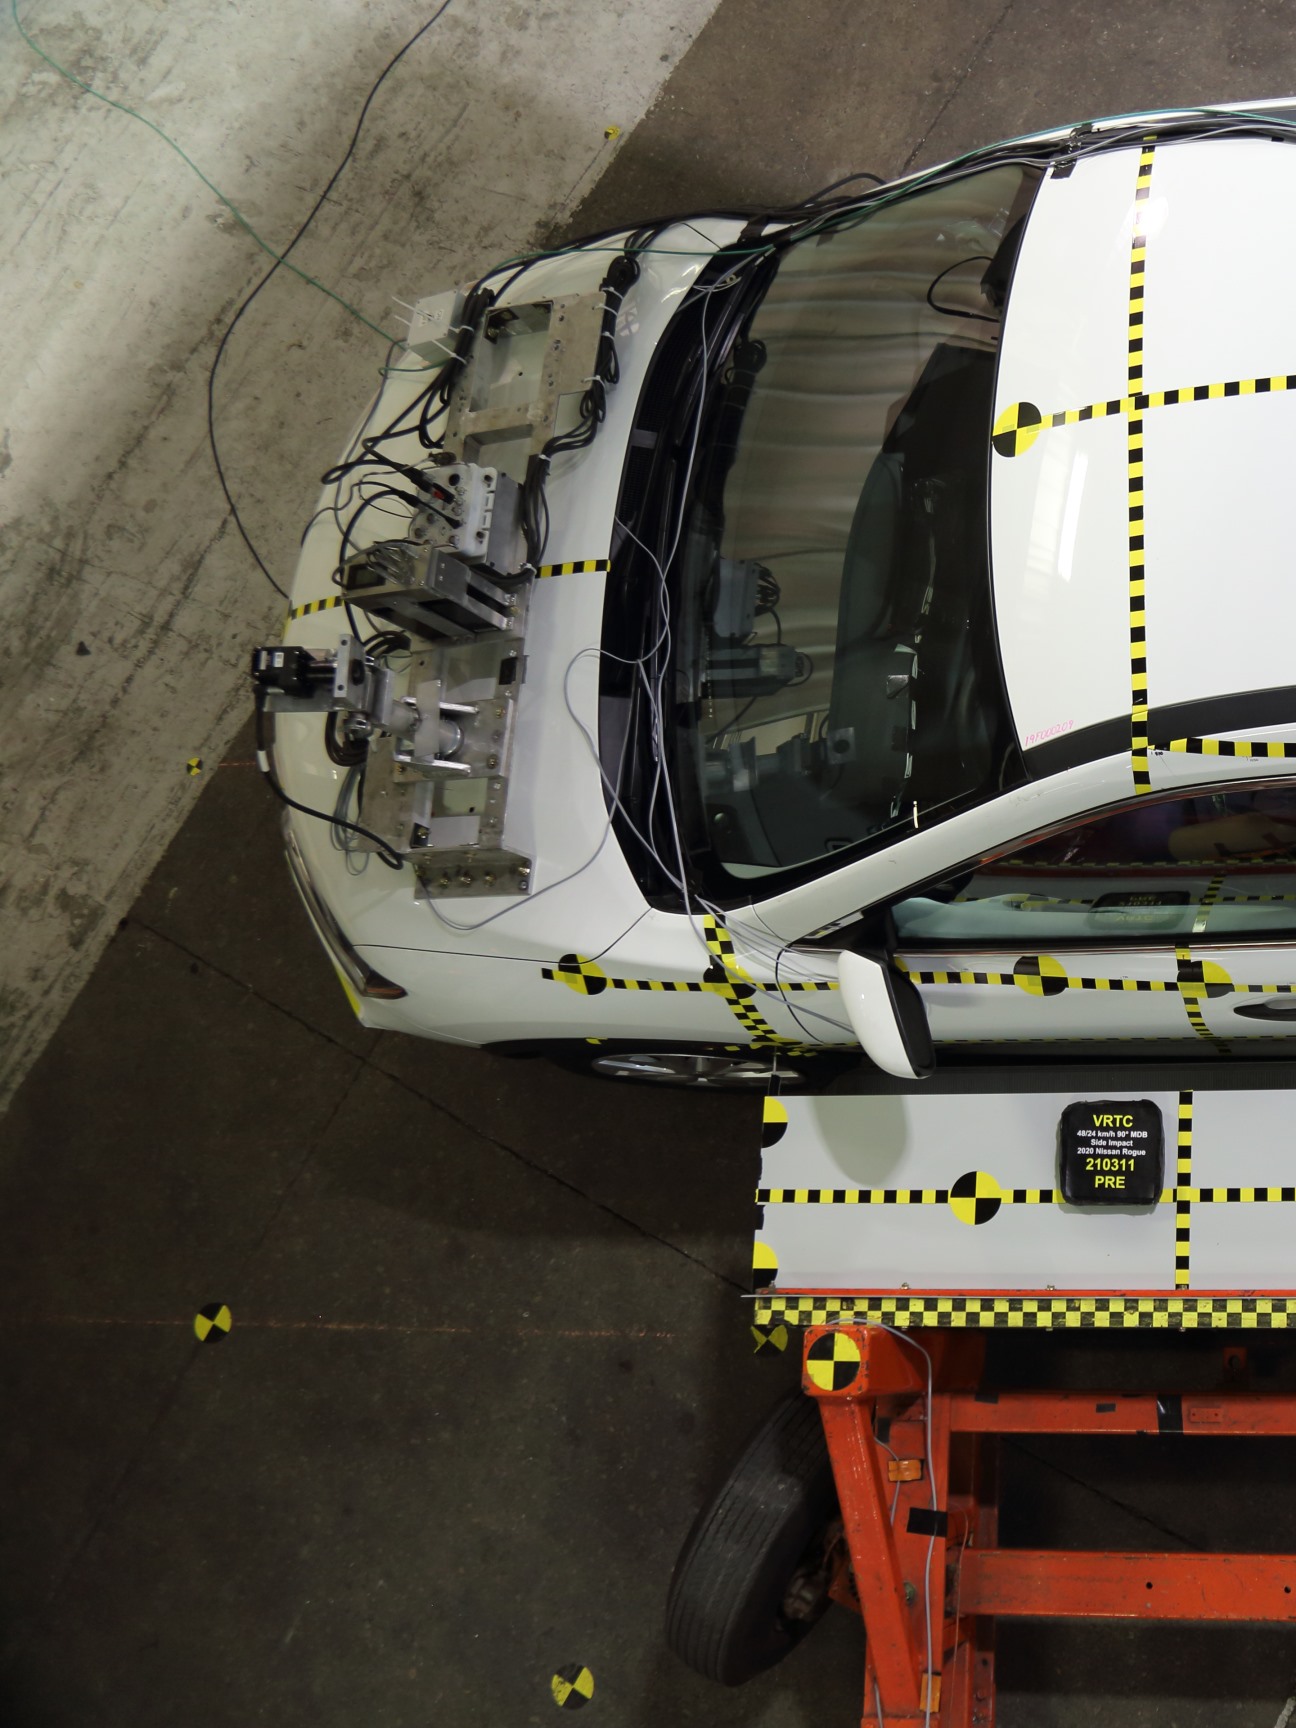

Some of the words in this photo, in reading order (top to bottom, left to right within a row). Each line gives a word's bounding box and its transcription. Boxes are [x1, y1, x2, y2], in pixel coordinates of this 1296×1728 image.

[1093, 1114, 1133, 1127] VRTC
[1098, 1130, 1115, 1138] km/h
[1108, 1139, 1133, 1147] Impact
[1085, 1158, 1134, 1171] 210311
[1095, 1176, 1125, 1188] PRE
